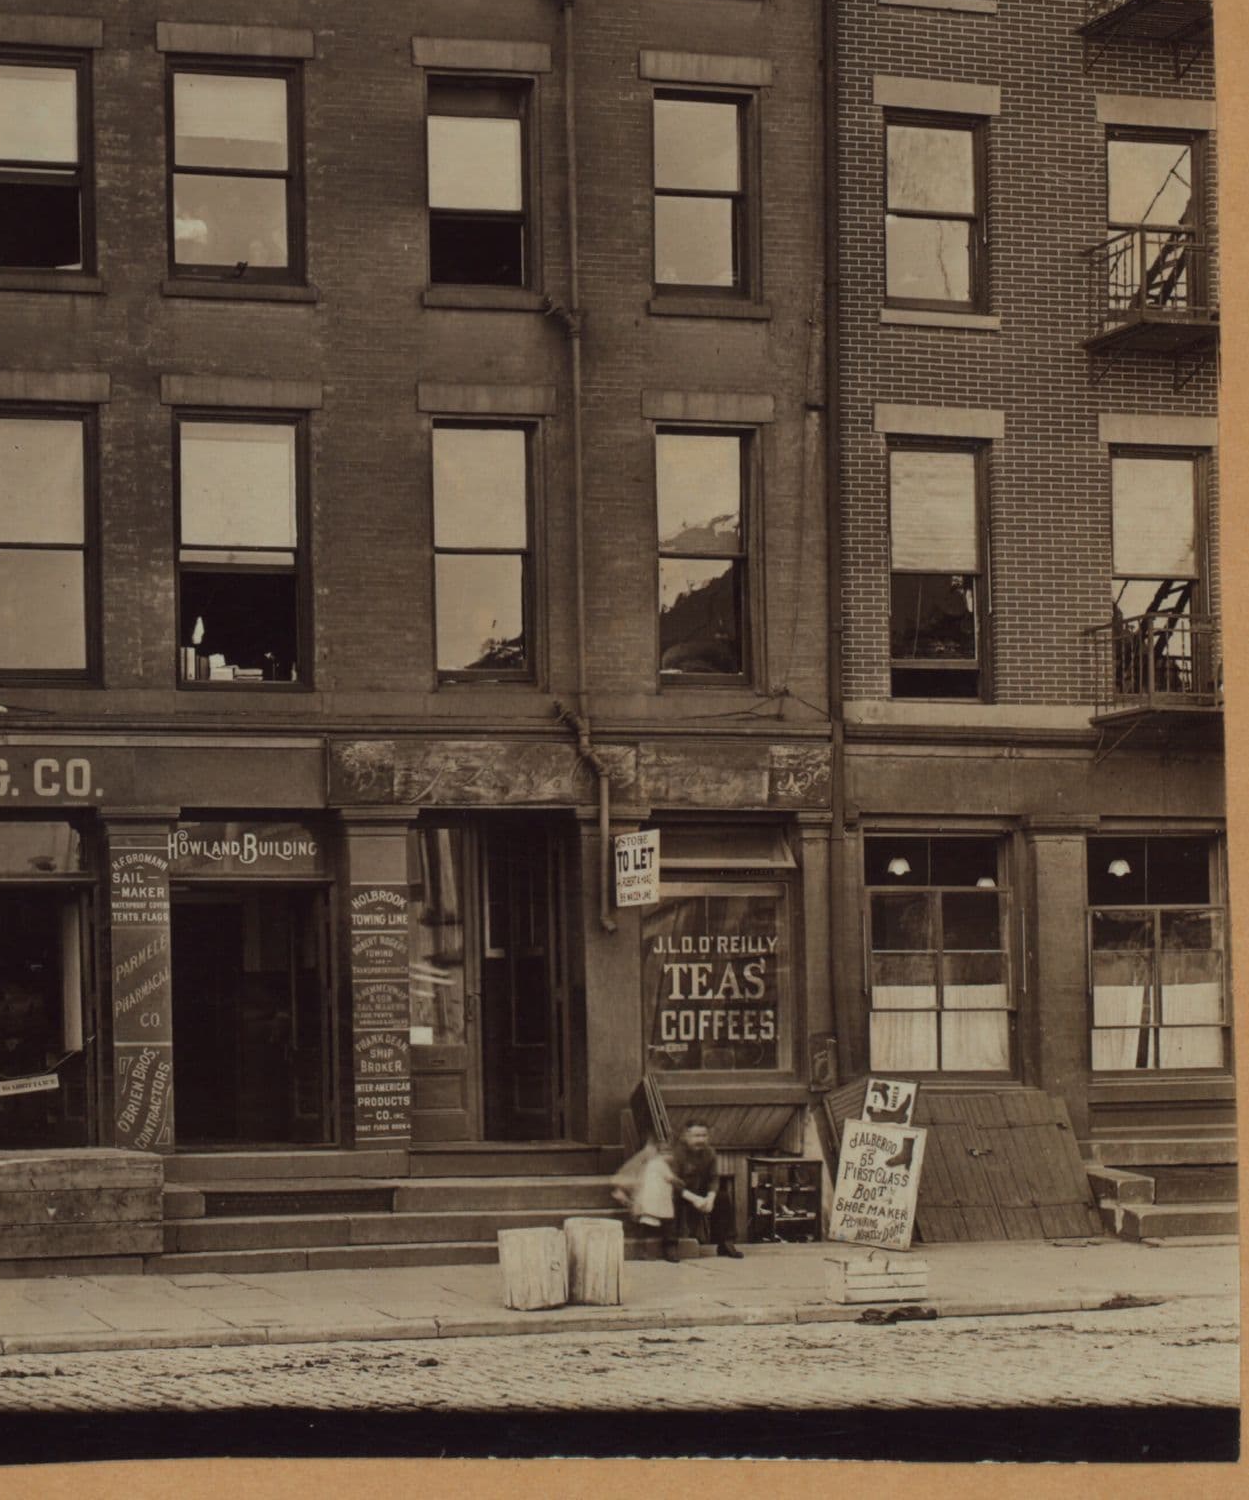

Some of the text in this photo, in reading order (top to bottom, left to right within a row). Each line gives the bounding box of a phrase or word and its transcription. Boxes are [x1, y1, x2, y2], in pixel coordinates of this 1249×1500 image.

[33, 756, 105, 797] CO.
[167, 829, 241, 861] HOWLAND
[617, 847, 654, 873] TO LET
[112, 872, 144, 884] SAIL
[121, 886, 165, 898] MAKER
[351, 890, 407, 910] HOLBROOK
[351, 913, 408, 925] TOWING LINE
[663, 957, 767, 1002] TEAS
[660, 1009, 776, 1042] COFFEES
[355, 1035, 384, 1053] FRANK
[369, 1047, 395, 1059] SHIP
[133, 1061, 171, 1150] CONTRACTORS
[357, 1095, 411, 1107] PRODUCTS
[844, 1161, 910, 1188] FIRST CLASS
[852, 1183, 887, 1202] BOOT
[835, 1197, 908, 1221] SHOE MAKER
